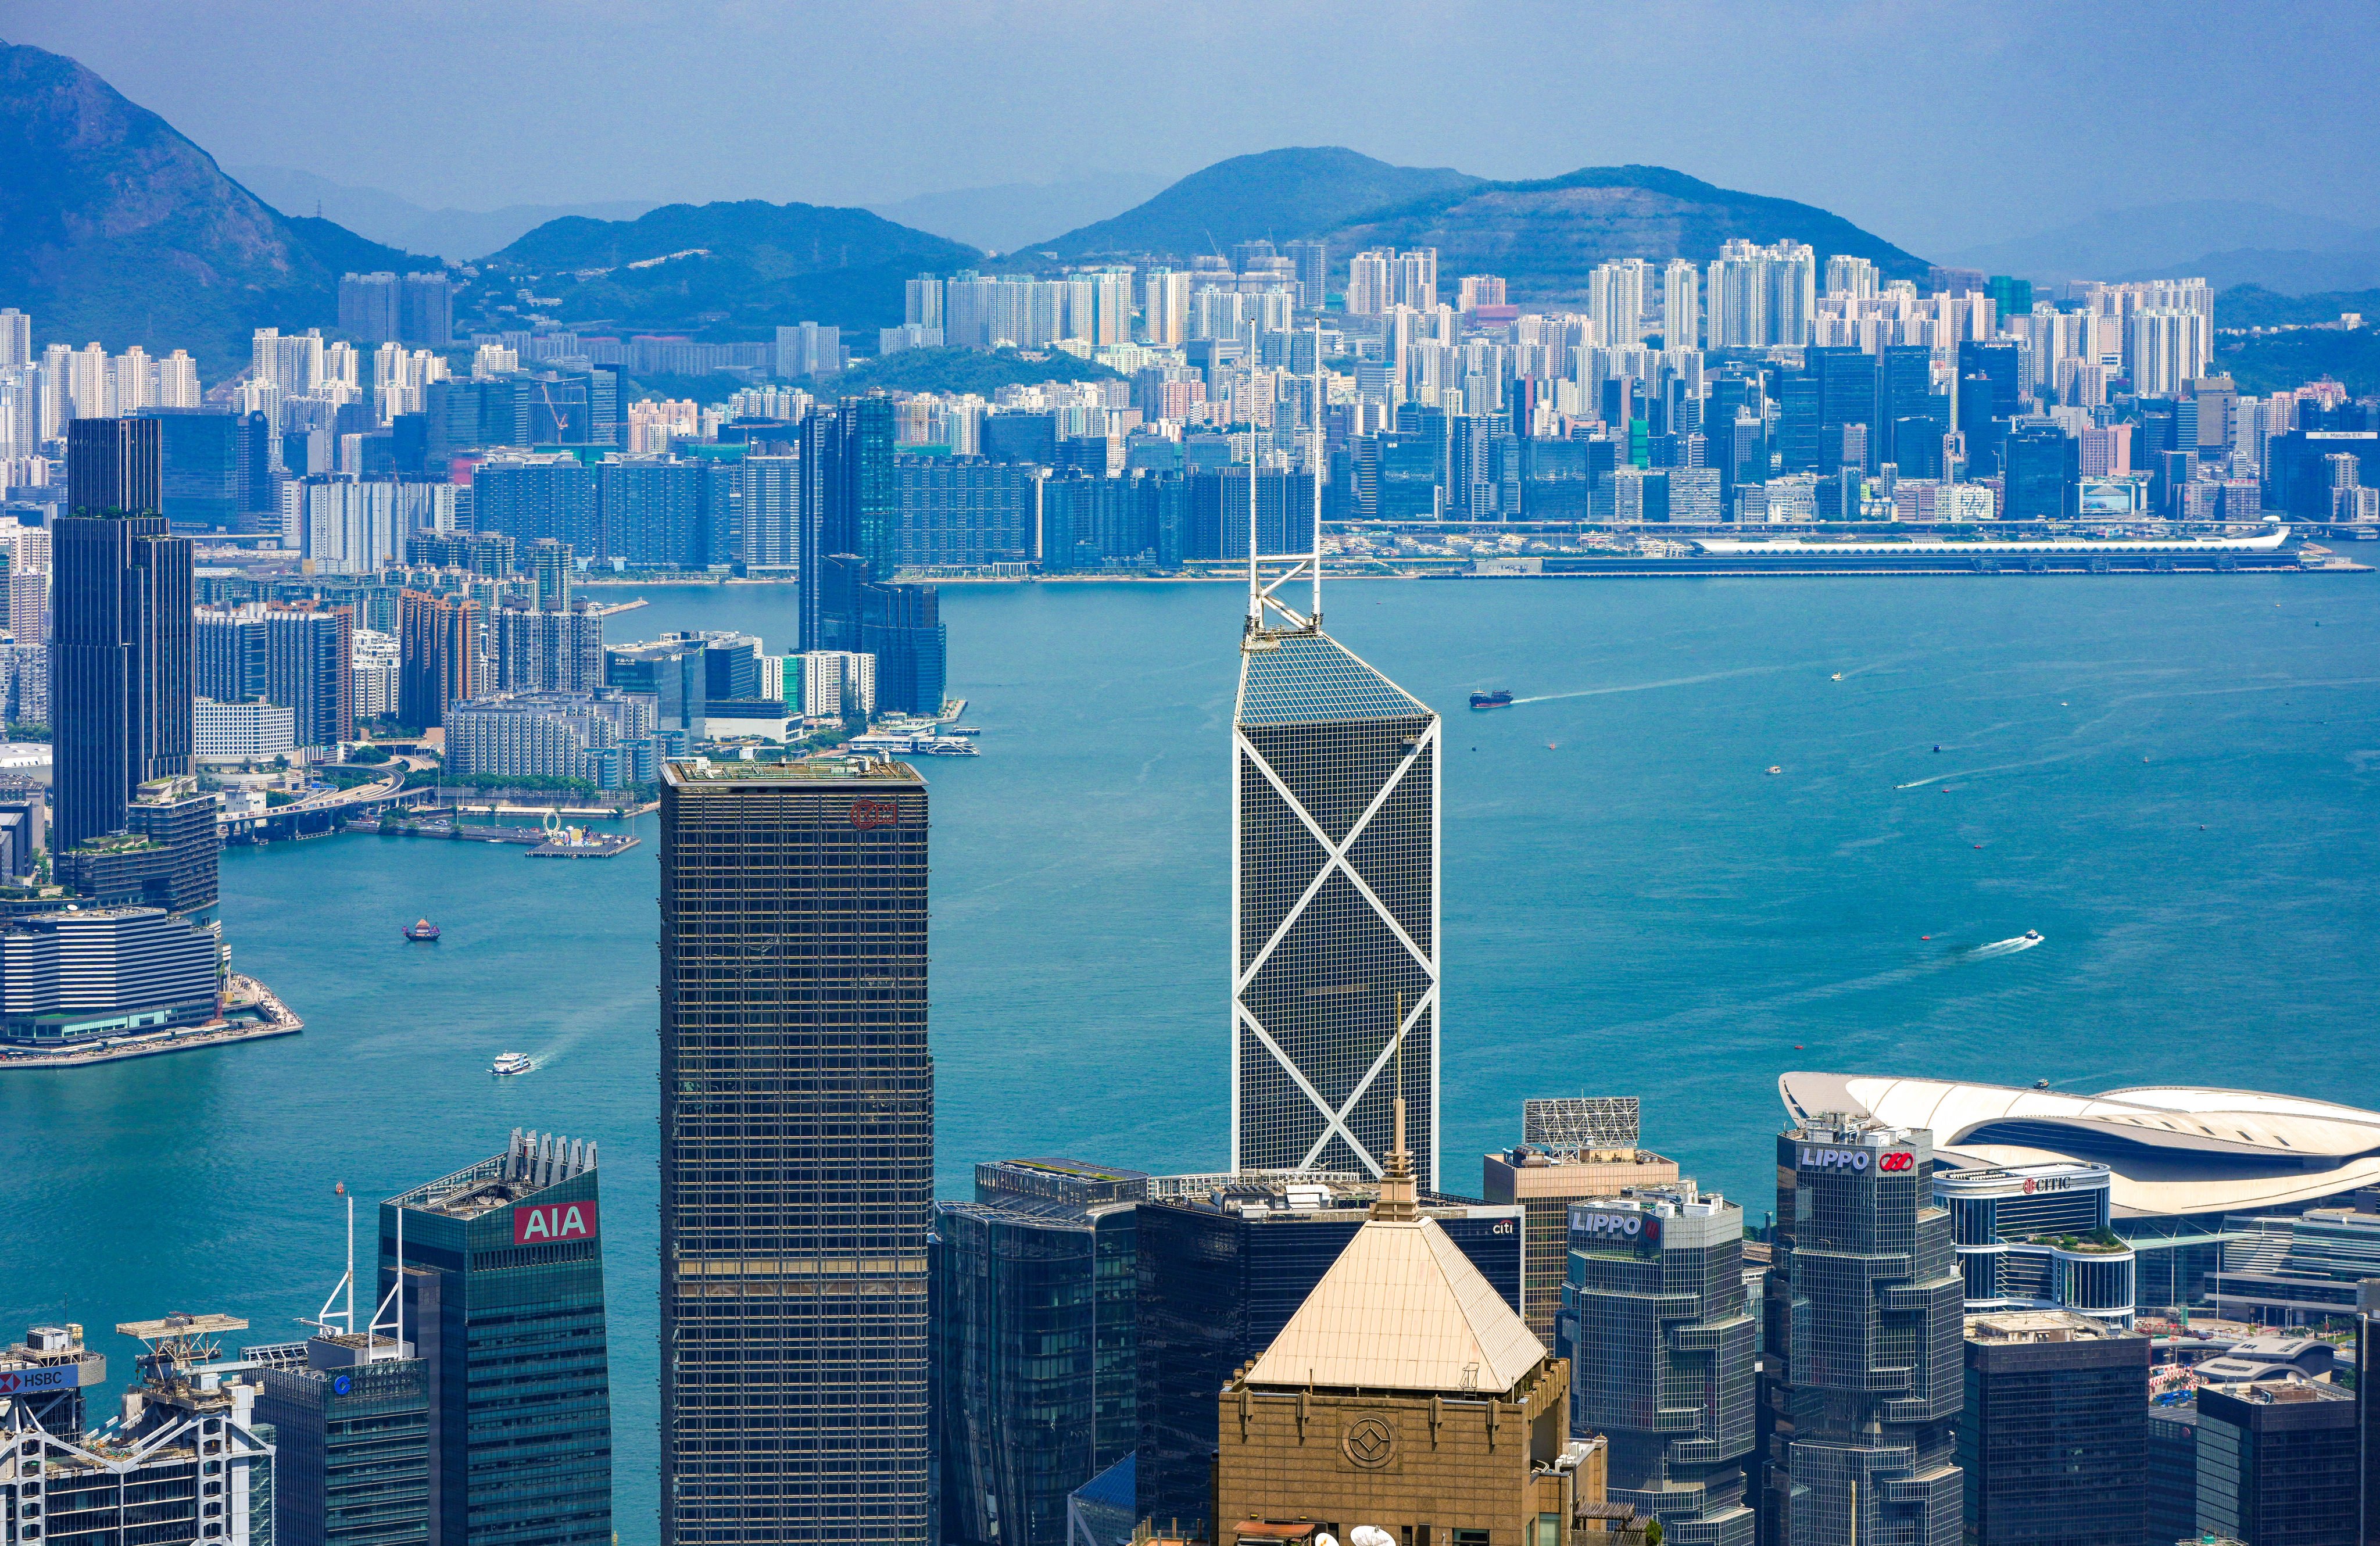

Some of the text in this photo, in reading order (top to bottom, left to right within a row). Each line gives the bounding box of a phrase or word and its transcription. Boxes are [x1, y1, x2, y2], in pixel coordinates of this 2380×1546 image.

[1802, 1148, 1869, 1170] LIPPO
[2036, 1176, 2070, 1191] CITIC
[524, 1206, 586, 1240] AIA
[1493, 1221, 1513, 1234] citi
[1572, 1212, 1641, 1235] LIPPO
[24, 1371, 62, 1387] HSBC
